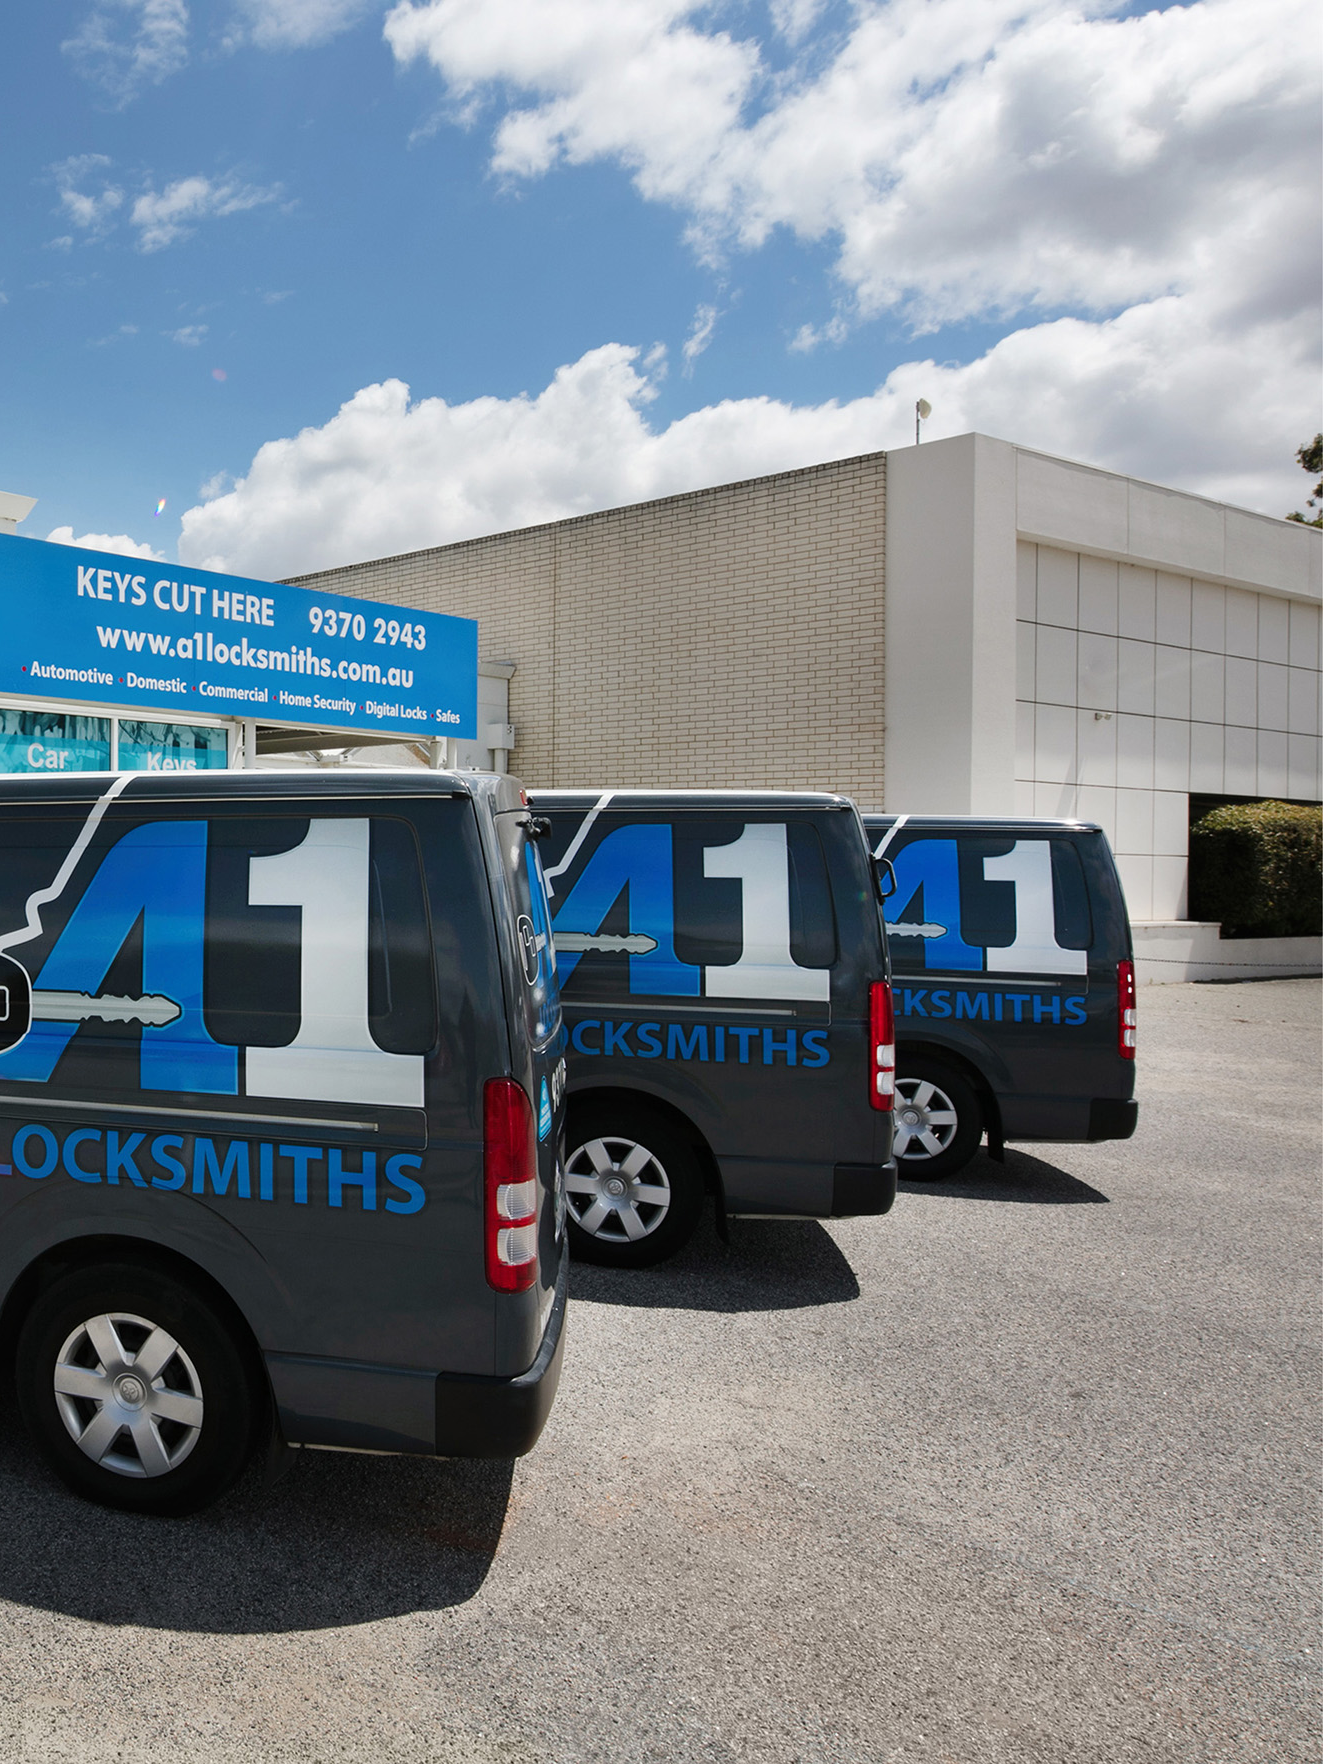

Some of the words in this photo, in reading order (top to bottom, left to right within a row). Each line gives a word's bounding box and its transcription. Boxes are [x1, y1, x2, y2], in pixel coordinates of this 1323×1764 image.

[77, 565, 147, 606] KEYS
[153, 579, 206, 615] CUT
[212, 589, 275, 627] HERE
[308, 606, 366, 641] 9370
[373, 618, 427, 651] 2943
[96, 625, 414, 689] www.a1locksmiths.com.au
[30, 660, 114, 685] Automotive
[127, 672, 188, 694] Domestic
[199, 681, 269, 703] Commercial
[279, 690, 312, 708] Home
[314, 694, 356, 715] Security
[366, 700, 399, 719] Digital
[400, 704, 428, 721] Locks
[436, 708, 461, 724] Safes
[27, 742, 70, 769] Car
[892, 987, 1088, 1026] KSMITHS
[563, 1019, 830, 1068] CKSMITHS
